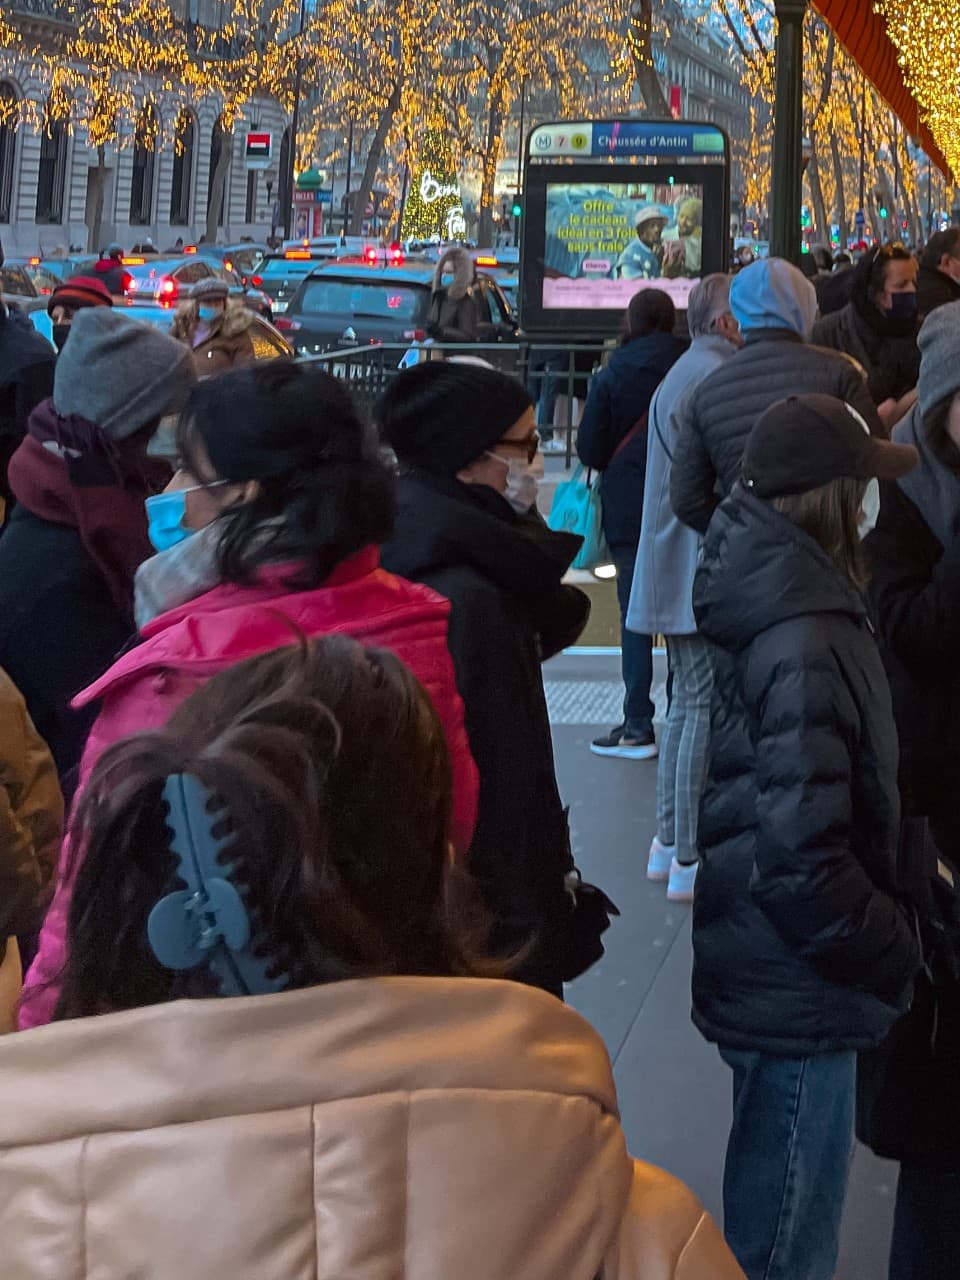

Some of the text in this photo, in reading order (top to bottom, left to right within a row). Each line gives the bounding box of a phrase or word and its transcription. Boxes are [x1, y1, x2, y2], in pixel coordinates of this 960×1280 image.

[558, 136, 565, 147] 7
[575, 136, 583, 147] 9
[649, 135, 688, 147] d'Antin
[583, 200, 614, 213] Offre
[582, 213, 627, 225] cadeau
